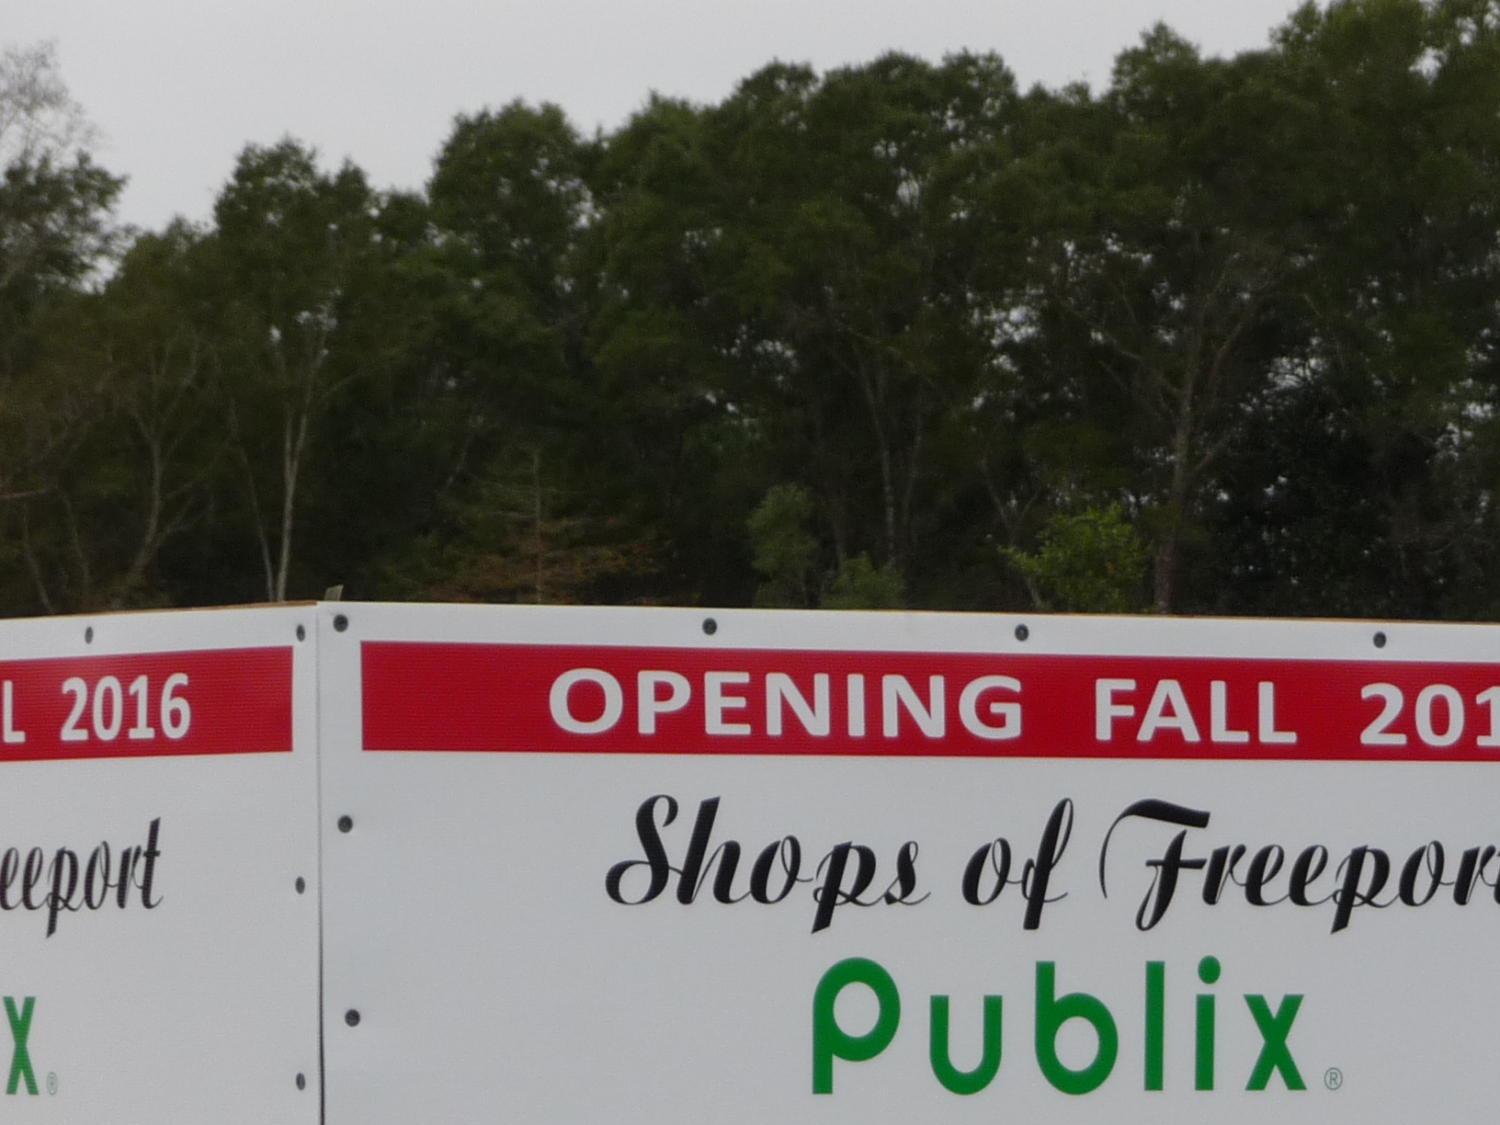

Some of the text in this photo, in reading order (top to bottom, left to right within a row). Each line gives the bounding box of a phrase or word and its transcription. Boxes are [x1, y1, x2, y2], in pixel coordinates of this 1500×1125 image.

[60, 673, 192, 742] 2016
[549, 667, 1023, 740] OPENING
[1094, 678, 1298, 743] FALL
[604, 794, 932, 934] Shops
[961, 797, 1075, 931] of
[812, 955, 1308, 1096] Publix
